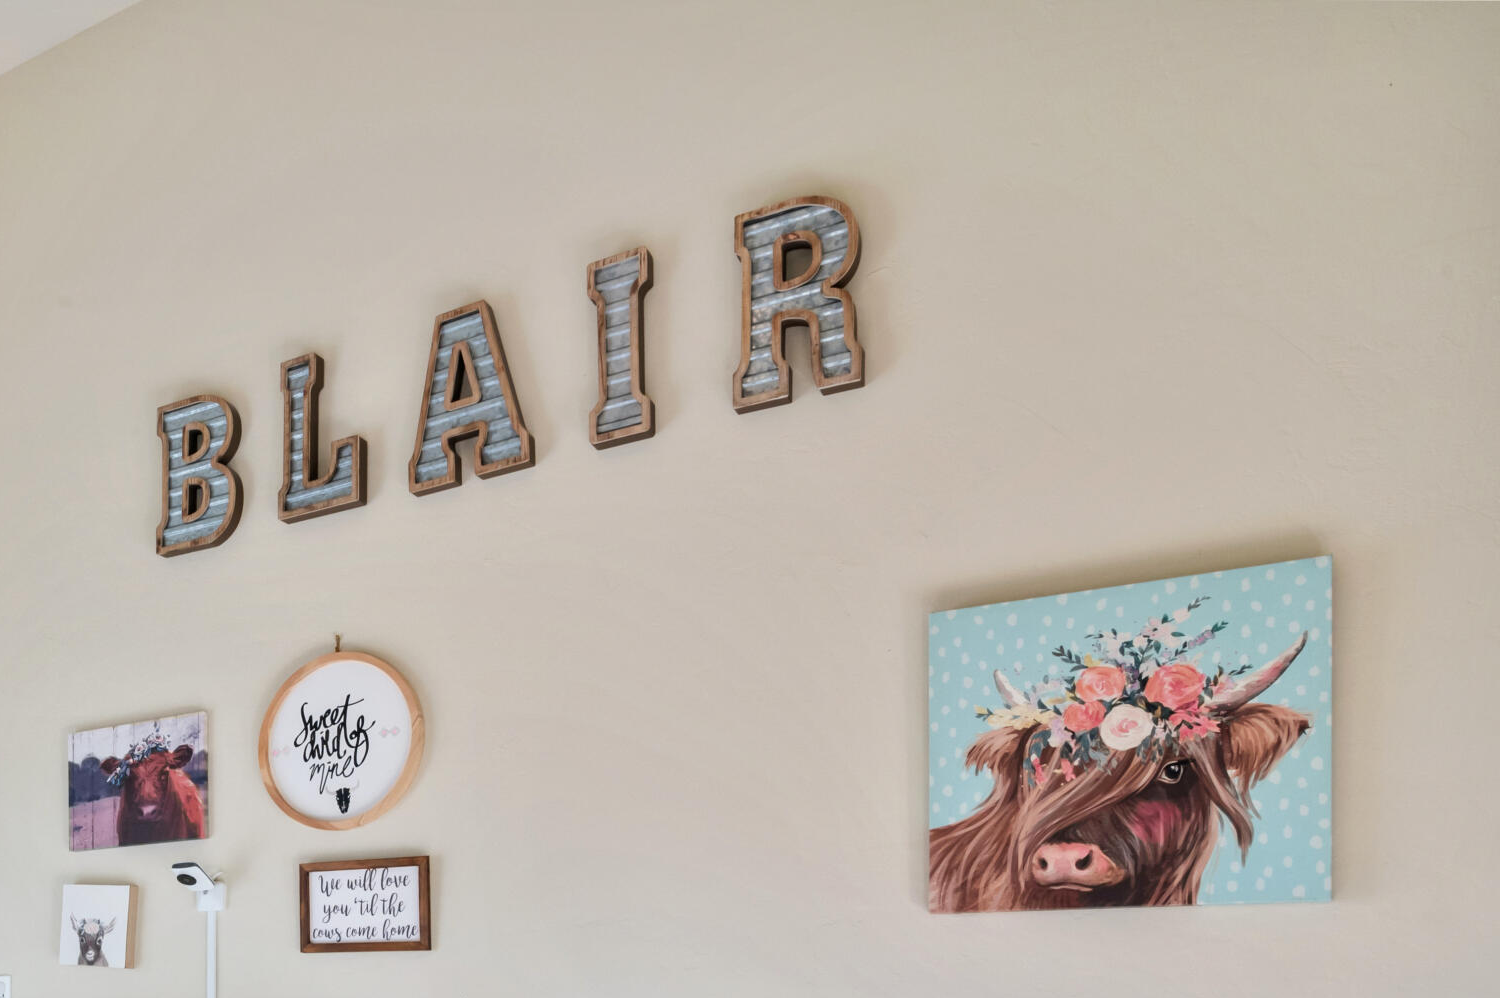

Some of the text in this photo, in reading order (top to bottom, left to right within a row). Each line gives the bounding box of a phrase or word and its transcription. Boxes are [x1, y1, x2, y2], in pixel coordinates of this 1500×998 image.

[156, 196, 865, 558] BLAIR
[293, 694, 364, 747] Sweet
[302, 715, 376, 768] child of
[309, 755, 355, 795] mine
[318, 867, 410, 897] We will love
[322, 904, 351, 924] you
[380, 892, 406, 917] the
[312, 918, 418, 943] cows come home
